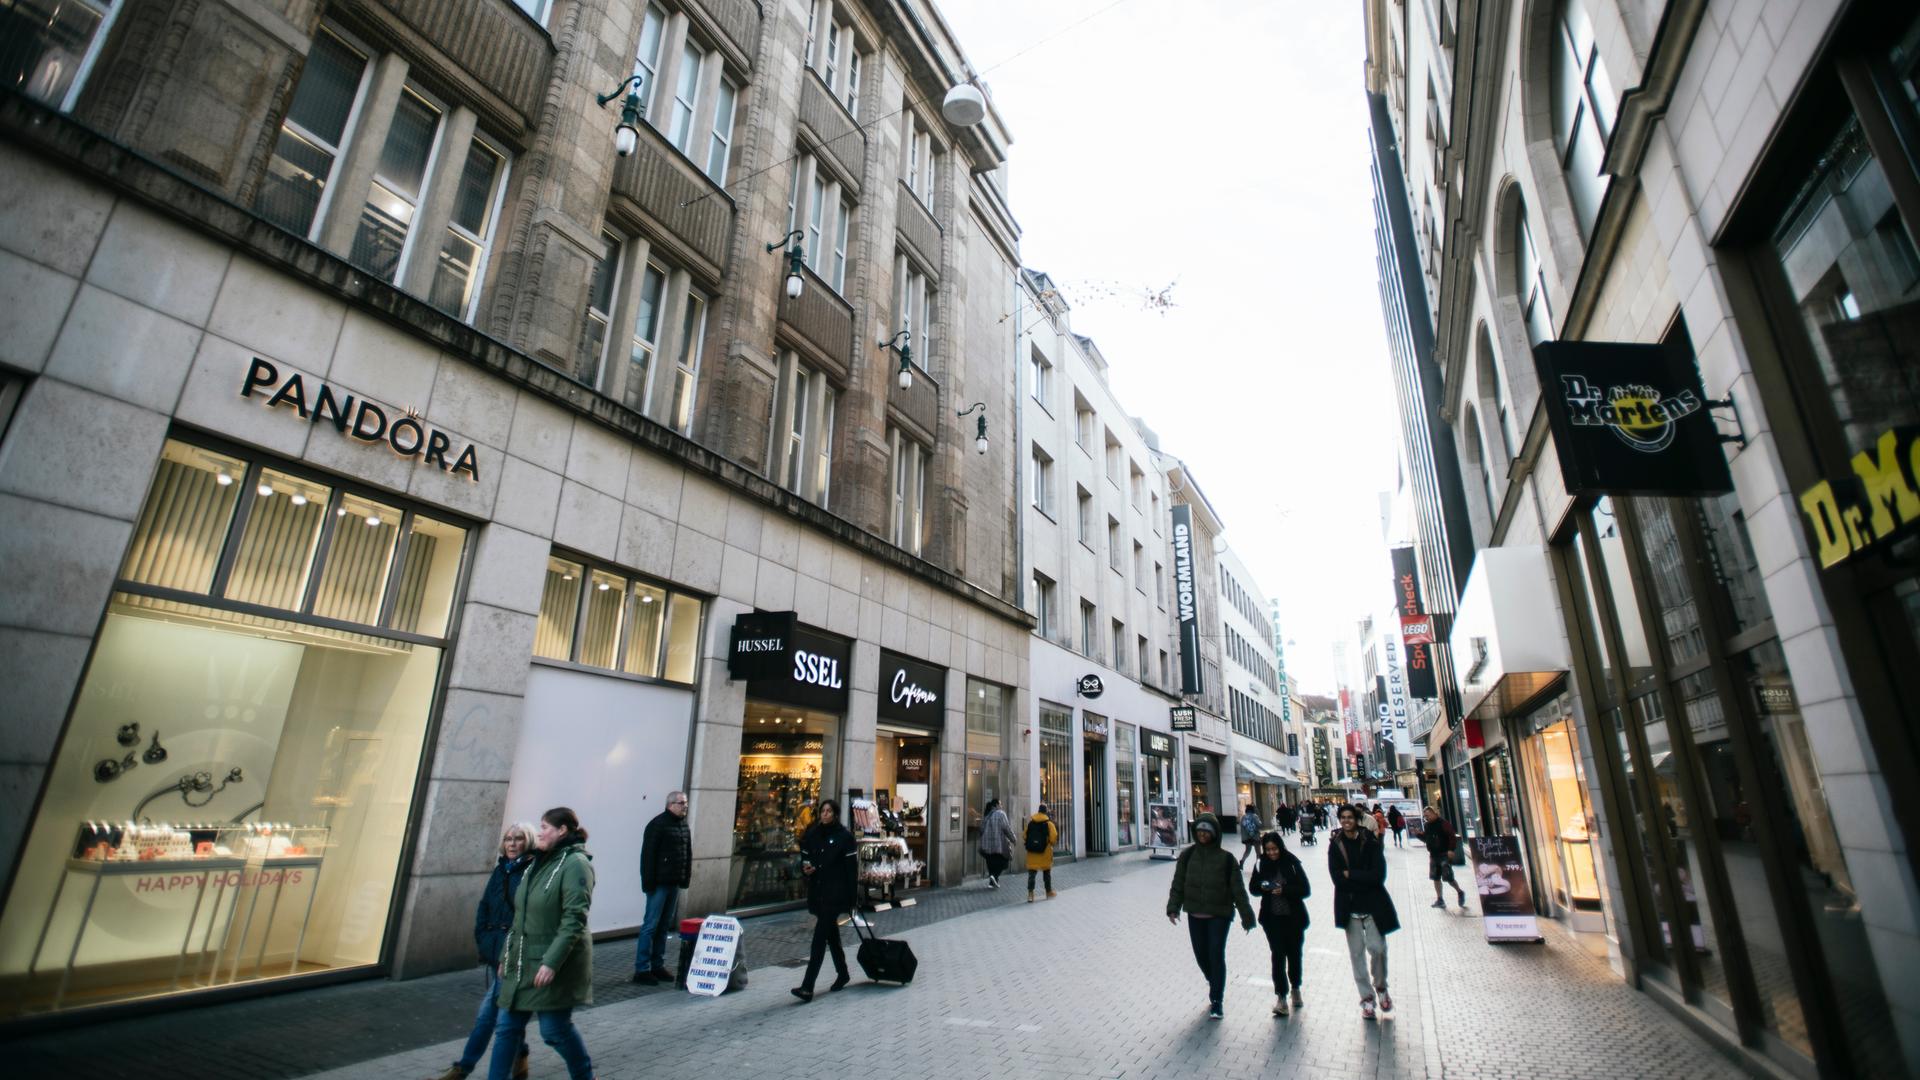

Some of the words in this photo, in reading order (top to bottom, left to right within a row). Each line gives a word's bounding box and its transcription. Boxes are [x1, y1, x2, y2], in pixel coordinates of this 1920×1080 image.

[1560, 374, 1602, 400] Dr.
[241, 356, 479, 482] PANDORA
[1568, 389, 1701, 426] Martens
[1175, 524, 1194, 622] WORMLAND
[1404, 623, 1428, 635] LEGO
[737, 638, 784, 653] HUSSEL
[793, 650, 843, 689] SSEL
[1386, 642, 1407, 729] RESERVED
[1379, 703, 1394, 744] ONLY
[136, 873, 207, 892] HAPPY
[213, 871, 303, 888] HOLIDAYS
[715, 934, 733, 942] CANCER
[703, 957, 717, 965] YEARS
[690, 968, 706, 976] PLEASE
[707, 970, 718, 978] HELP
[696, 981, 715, 990] THANKS
